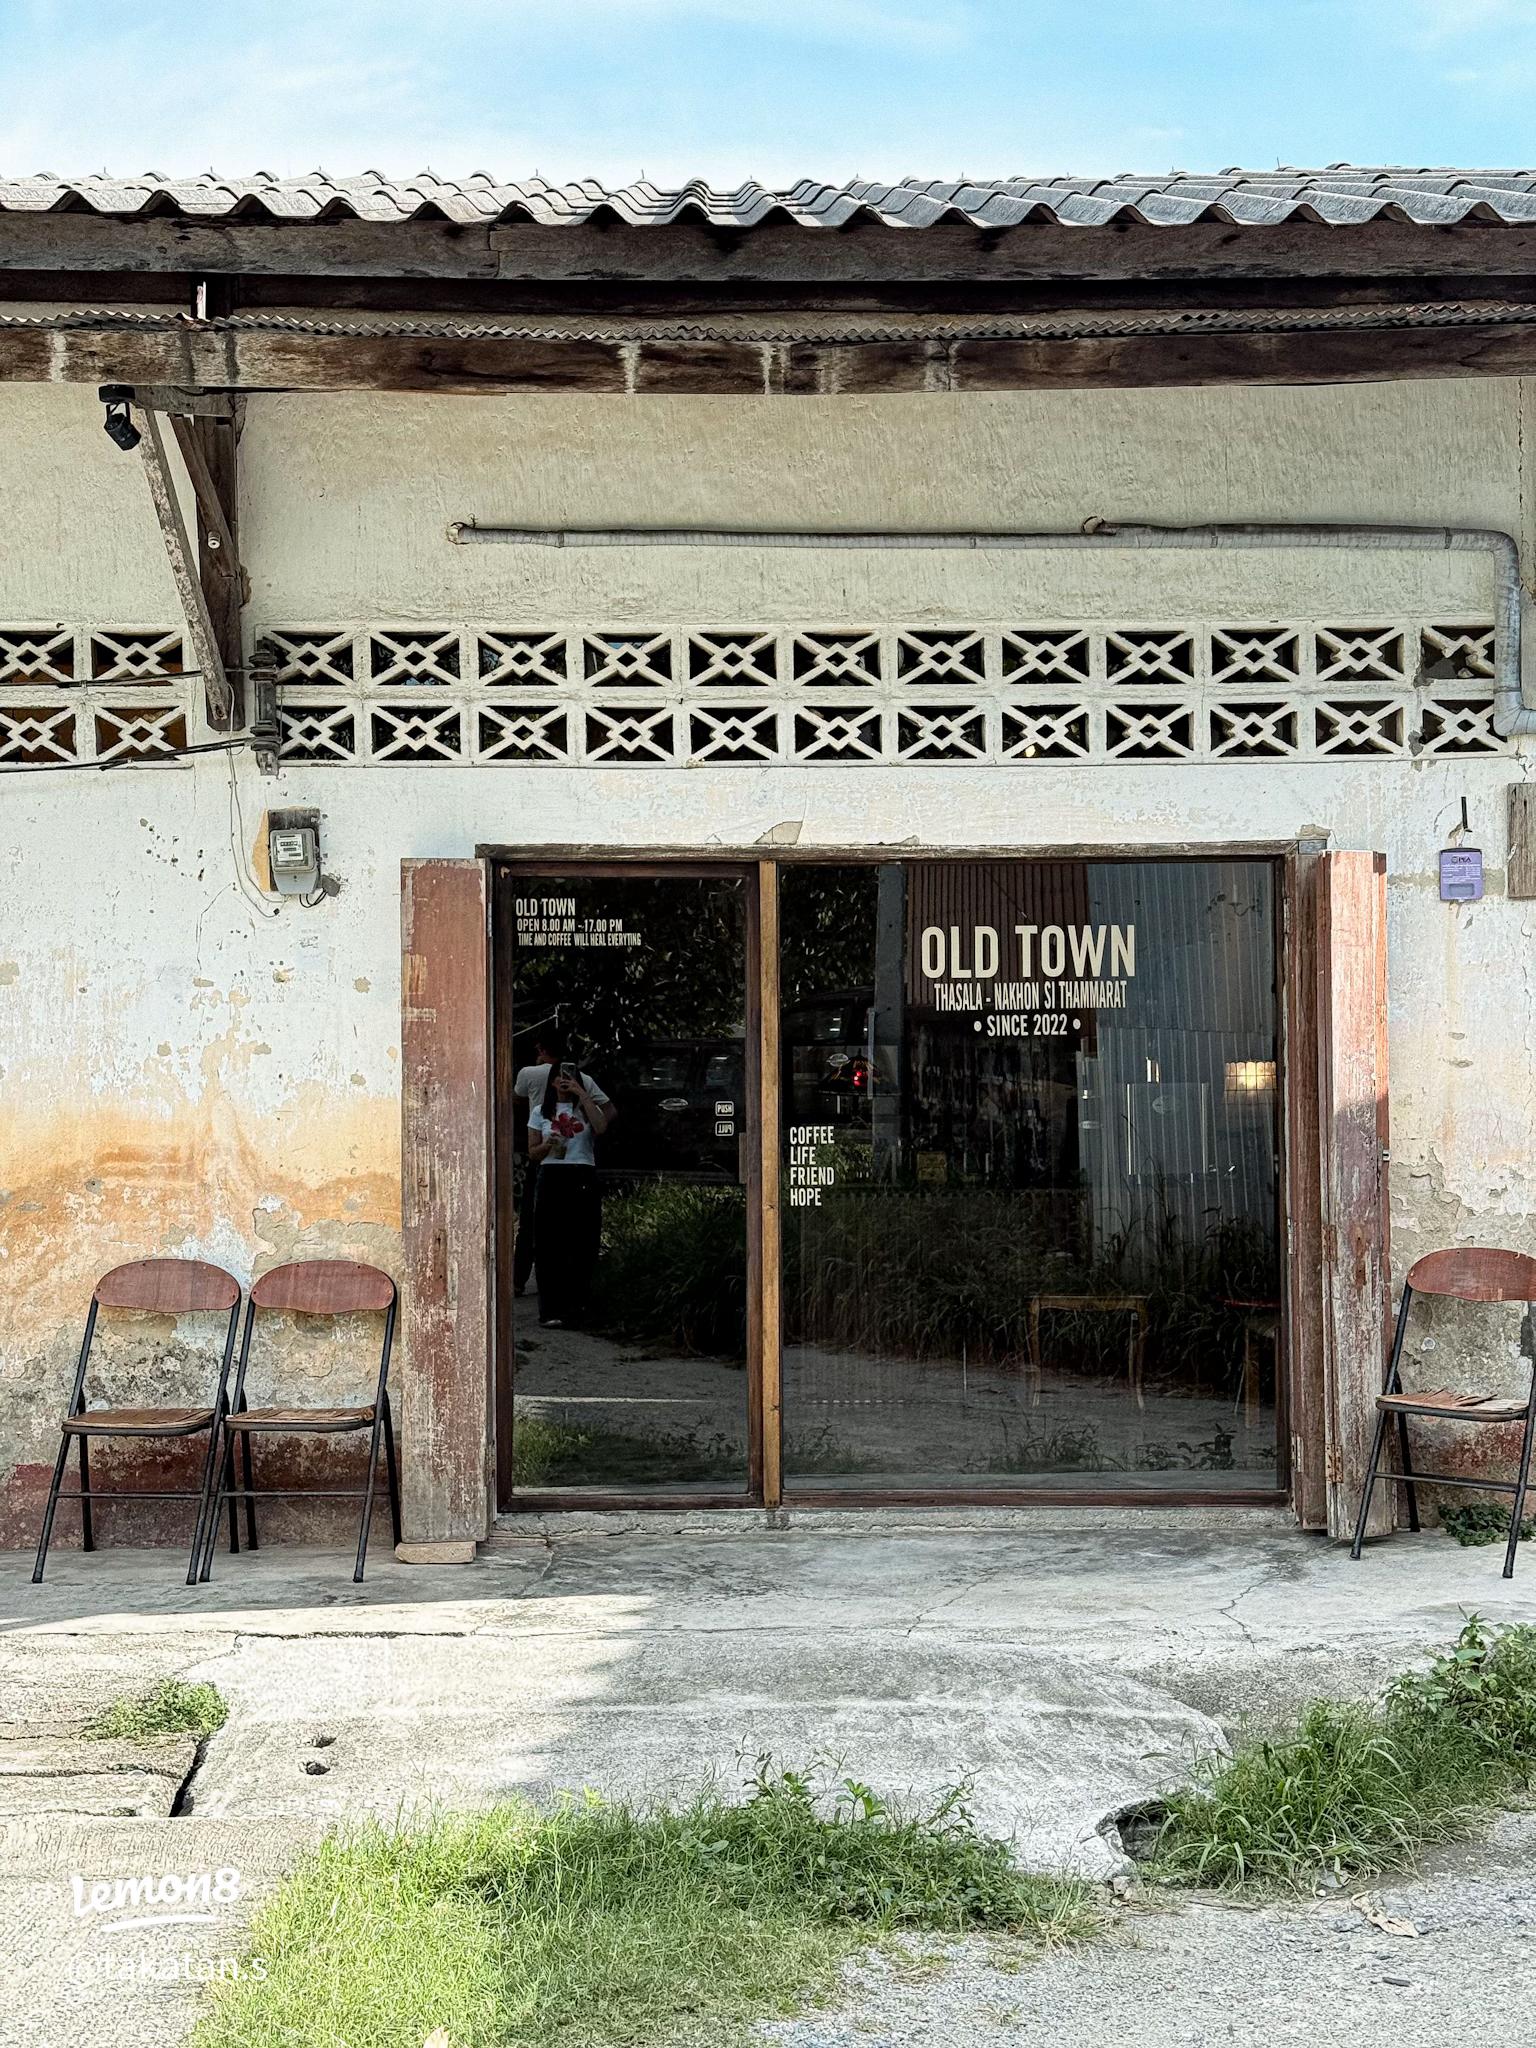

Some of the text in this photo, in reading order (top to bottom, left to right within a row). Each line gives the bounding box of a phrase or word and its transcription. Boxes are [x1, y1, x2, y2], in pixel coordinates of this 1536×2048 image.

[515, 898, 576, 916] OLD TOWN
[517, 918, 540, 932] OPEN
[542, 918, 560, 932] 8.00
[562, 918, 576, 932] AM
[584, 919, 607, 932] 17.00
[609, 918, 623, 932] PM
[517, 932, 642, 946] TIME AND COFFEE WILL HEAL EVERYTING
[921, 924, 1136, 978] OLD TOWN
[934, 982, 983, 1011] THASALA
[994, 981, 1040, 1010] NAKHON
[1044, 980, 1056, 1009] SI
[1058, 980, 1127, 1009] THAMMARAT
[986, 1013, 1068, 1036] SINCE 2022
[717, 1104, 732, 1114] PUSH
[789, 1125, 835, 1145] COFFEE
[790, 1146, 816, 1165] LIFE
[790, 1166, 835, 1186] FRIEND
[790, 1187, 822, 1207] HOPE
